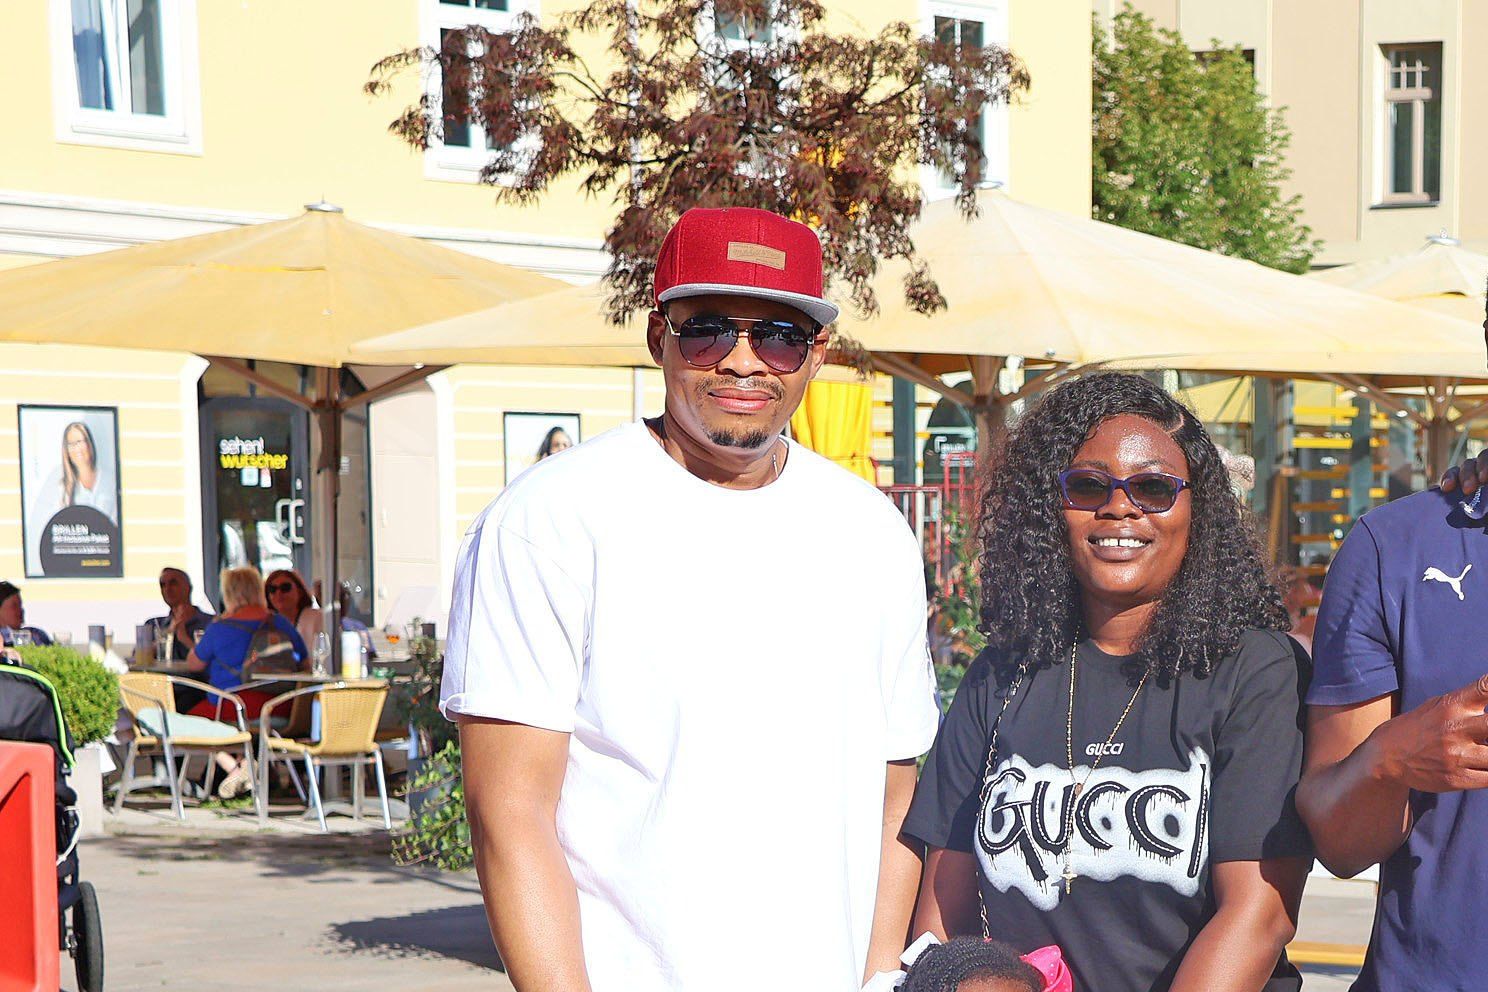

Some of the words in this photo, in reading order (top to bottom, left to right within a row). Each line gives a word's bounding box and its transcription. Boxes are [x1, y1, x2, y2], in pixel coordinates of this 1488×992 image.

[220, 452, 288, 469] wutscher
[1085, 742, 1124, 756] GUCCI
[978, 762, 1208, 882] GUCCI
